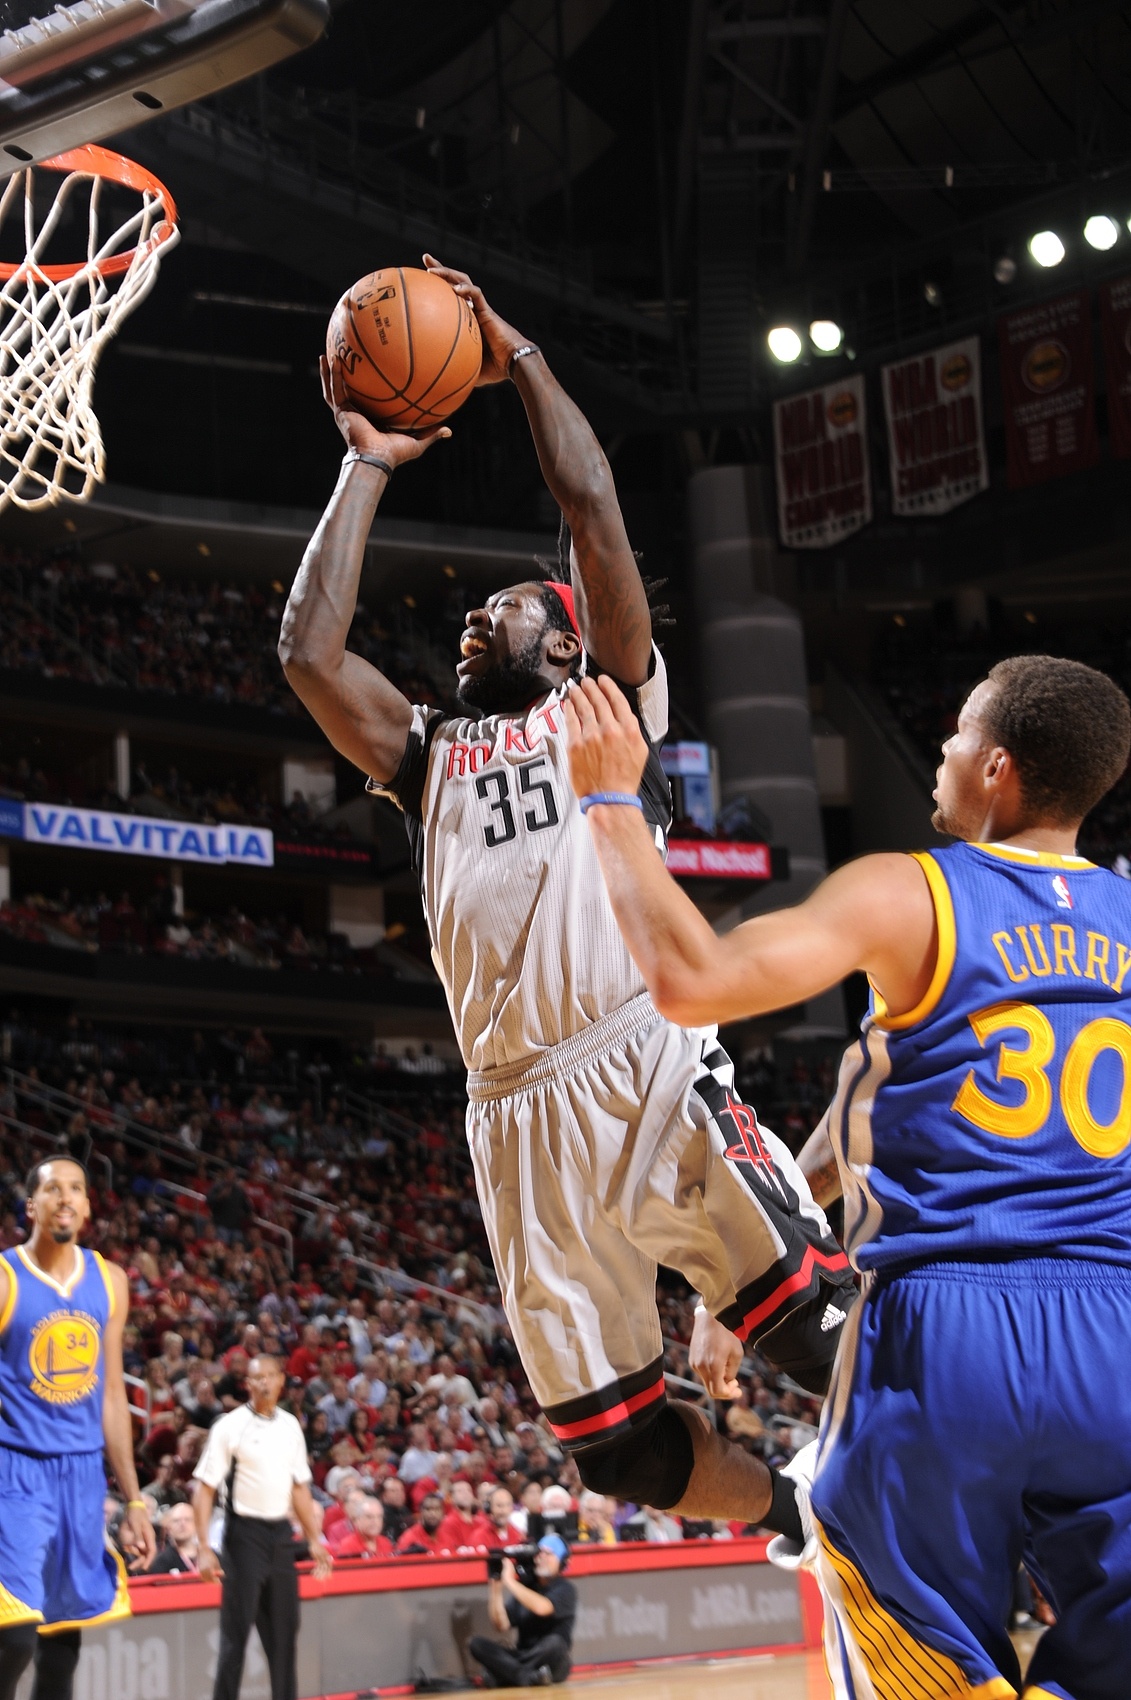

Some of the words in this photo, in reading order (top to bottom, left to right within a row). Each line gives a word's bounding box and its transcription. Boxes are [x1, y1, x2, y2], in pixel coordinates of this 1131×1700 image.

[447, 700, 566, 780] ROKET
[474, 758, 559, 848] 35
[30, 808, 268, 860] VALVITALIA
[991, 923, 1131, 994] CURRY
[950, 1000, 1131, 1159] 30
[66, 1331, 88, 1350] 34
[820, 1310, 847, 1333] adidas
[29, 1373, 99, 1407] WARRIORS
